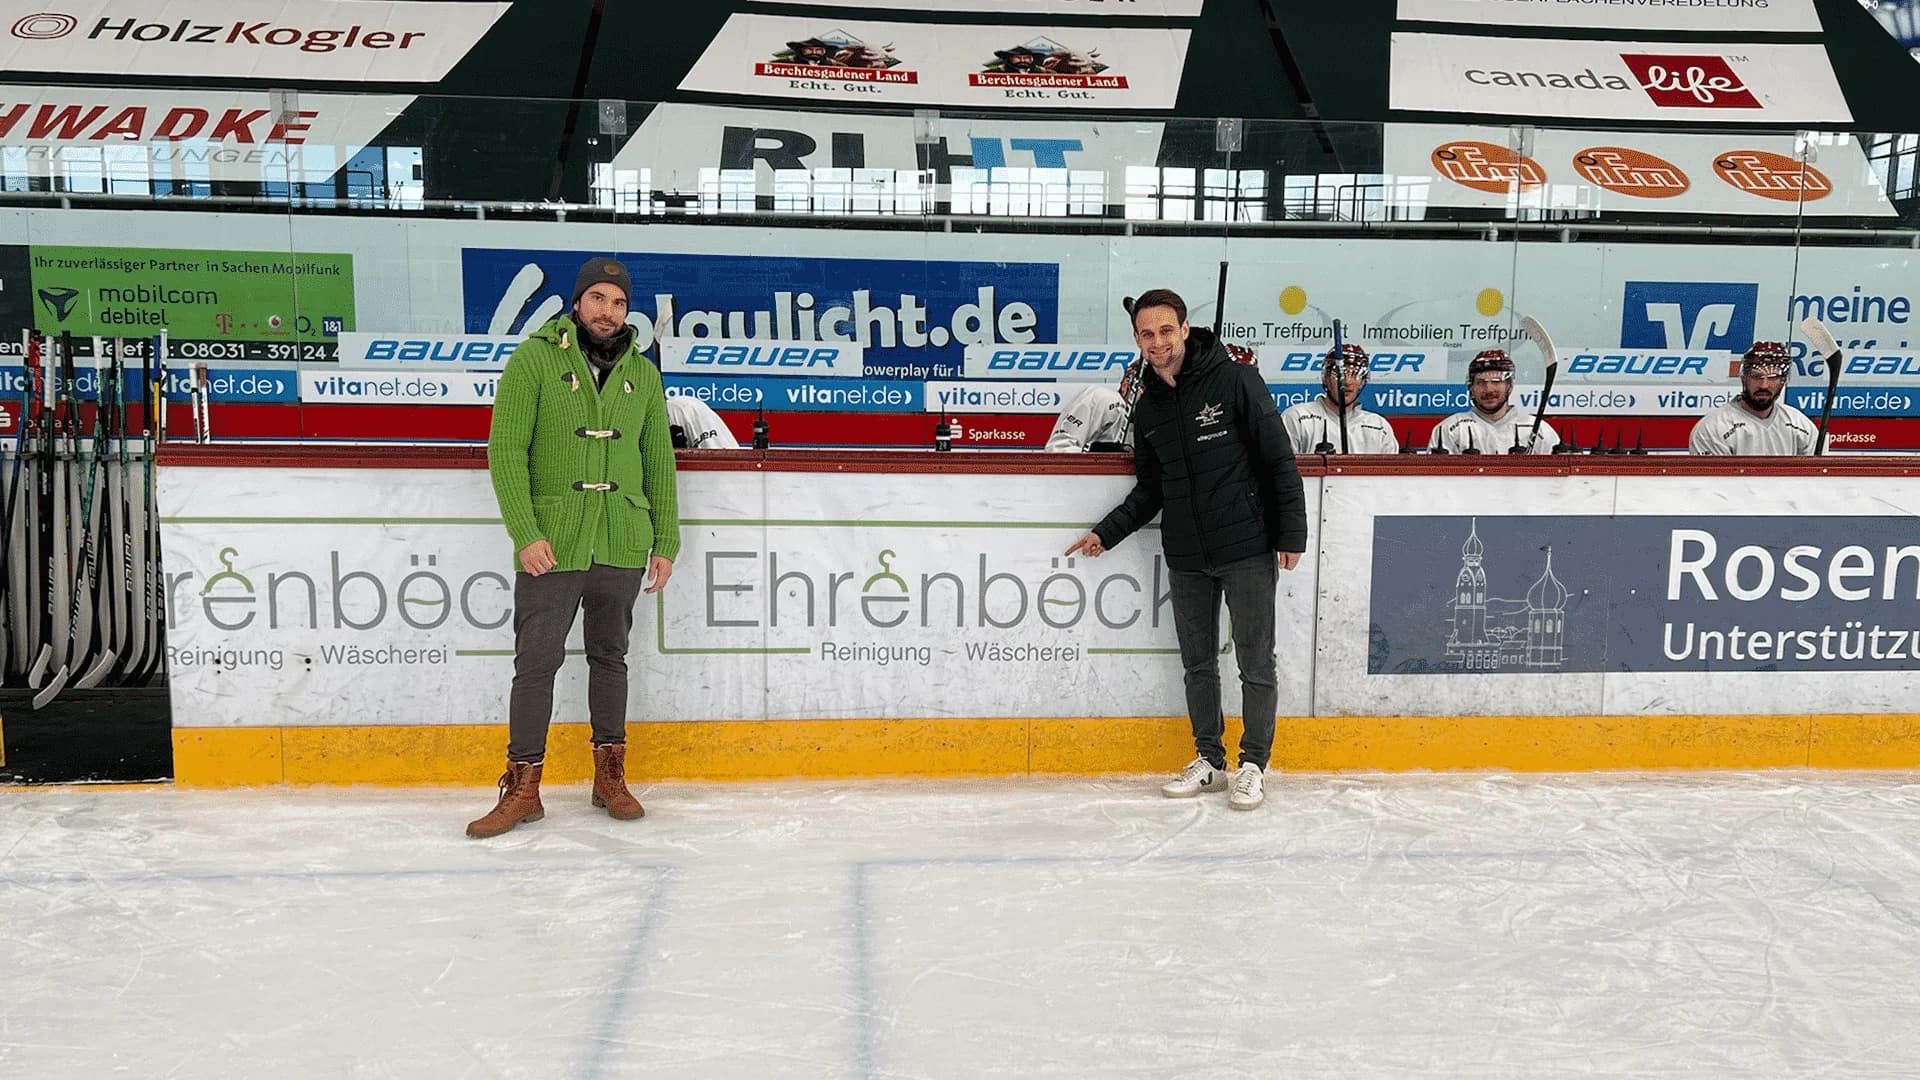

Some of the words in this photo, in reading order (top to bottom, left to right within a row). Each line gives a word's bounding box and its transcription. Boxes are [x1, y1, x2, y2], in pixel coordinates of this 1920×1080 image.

[88, 17, 426, 53] HolzKogler
[763, 63, 873, 81] Berchtesgadener
[876, 69, 909, 82] Land
[977, 74, 1084, 89] Berchtesgadener
[1087, 76, 1119, 88] Land
[789, 80, 836, 93] Echt.
[843, 82, 882, 94] Gut.
[1465, 68, 1632, 91] canada
[1640, 65, 1746, 103] life
[1004, 89, 1051, 100] Echt.
[1057, 90, 1096, 101] Gut.
[35, 256, 53, 267] Ihr
[57, 258, 146, 273] zuverlässiger
[150, 260, 199, 272] Partner
[207, 261, 219, 272] in
[222, 261, 269, 274] Sachen
[273, 262, 341, 276] Mobilfunk
[99, 285, 218, 305] mobilcom
[1787, 285, 1911, 324] meine
[100, 308, 169, 326] debitel
[1262, 323, 1349, 341] Treffpunt
[1363, 324, 1453, 340] Immobilien
[1459, 324, 1533, 343] Treffpun
[181, 342, 245, 358] 08031
[267, 344, 298, 360] 391
[303, 346, 326, 360] 24
[686, 345, 839, 368] BAUER
[987, 351, 1135, 371] BAUER
[1280, 352, 1426, 373] BAER
[1568, 355, 1709, 375] BAUER
[1844, 356, 1920, 375] BAU
[863, 364, 930, 379] owerplay
[933, 363, 953, 377] für
[314, 376, 438, 398] vitanet.de
[665, 383, 753, 402] anet.de
[787, 384, 902, 405] vitanet.de
[938, 387, 1052, 406] vitanet.de
[1374, 389, 1474, 408] vitanet.d
[1520, 390, 1627, 409] vianet.de
[968, 429, 1026, 441] Sparkasse
[1829, 432, 1877, 443] parkasse
[167, 646, 284, 671] Reinigung
[320, 645, 447, 666] Wäscherei
[821, 642, 931, 666] Reinigung
[965, 642, 1081, 662] Wäscherei
